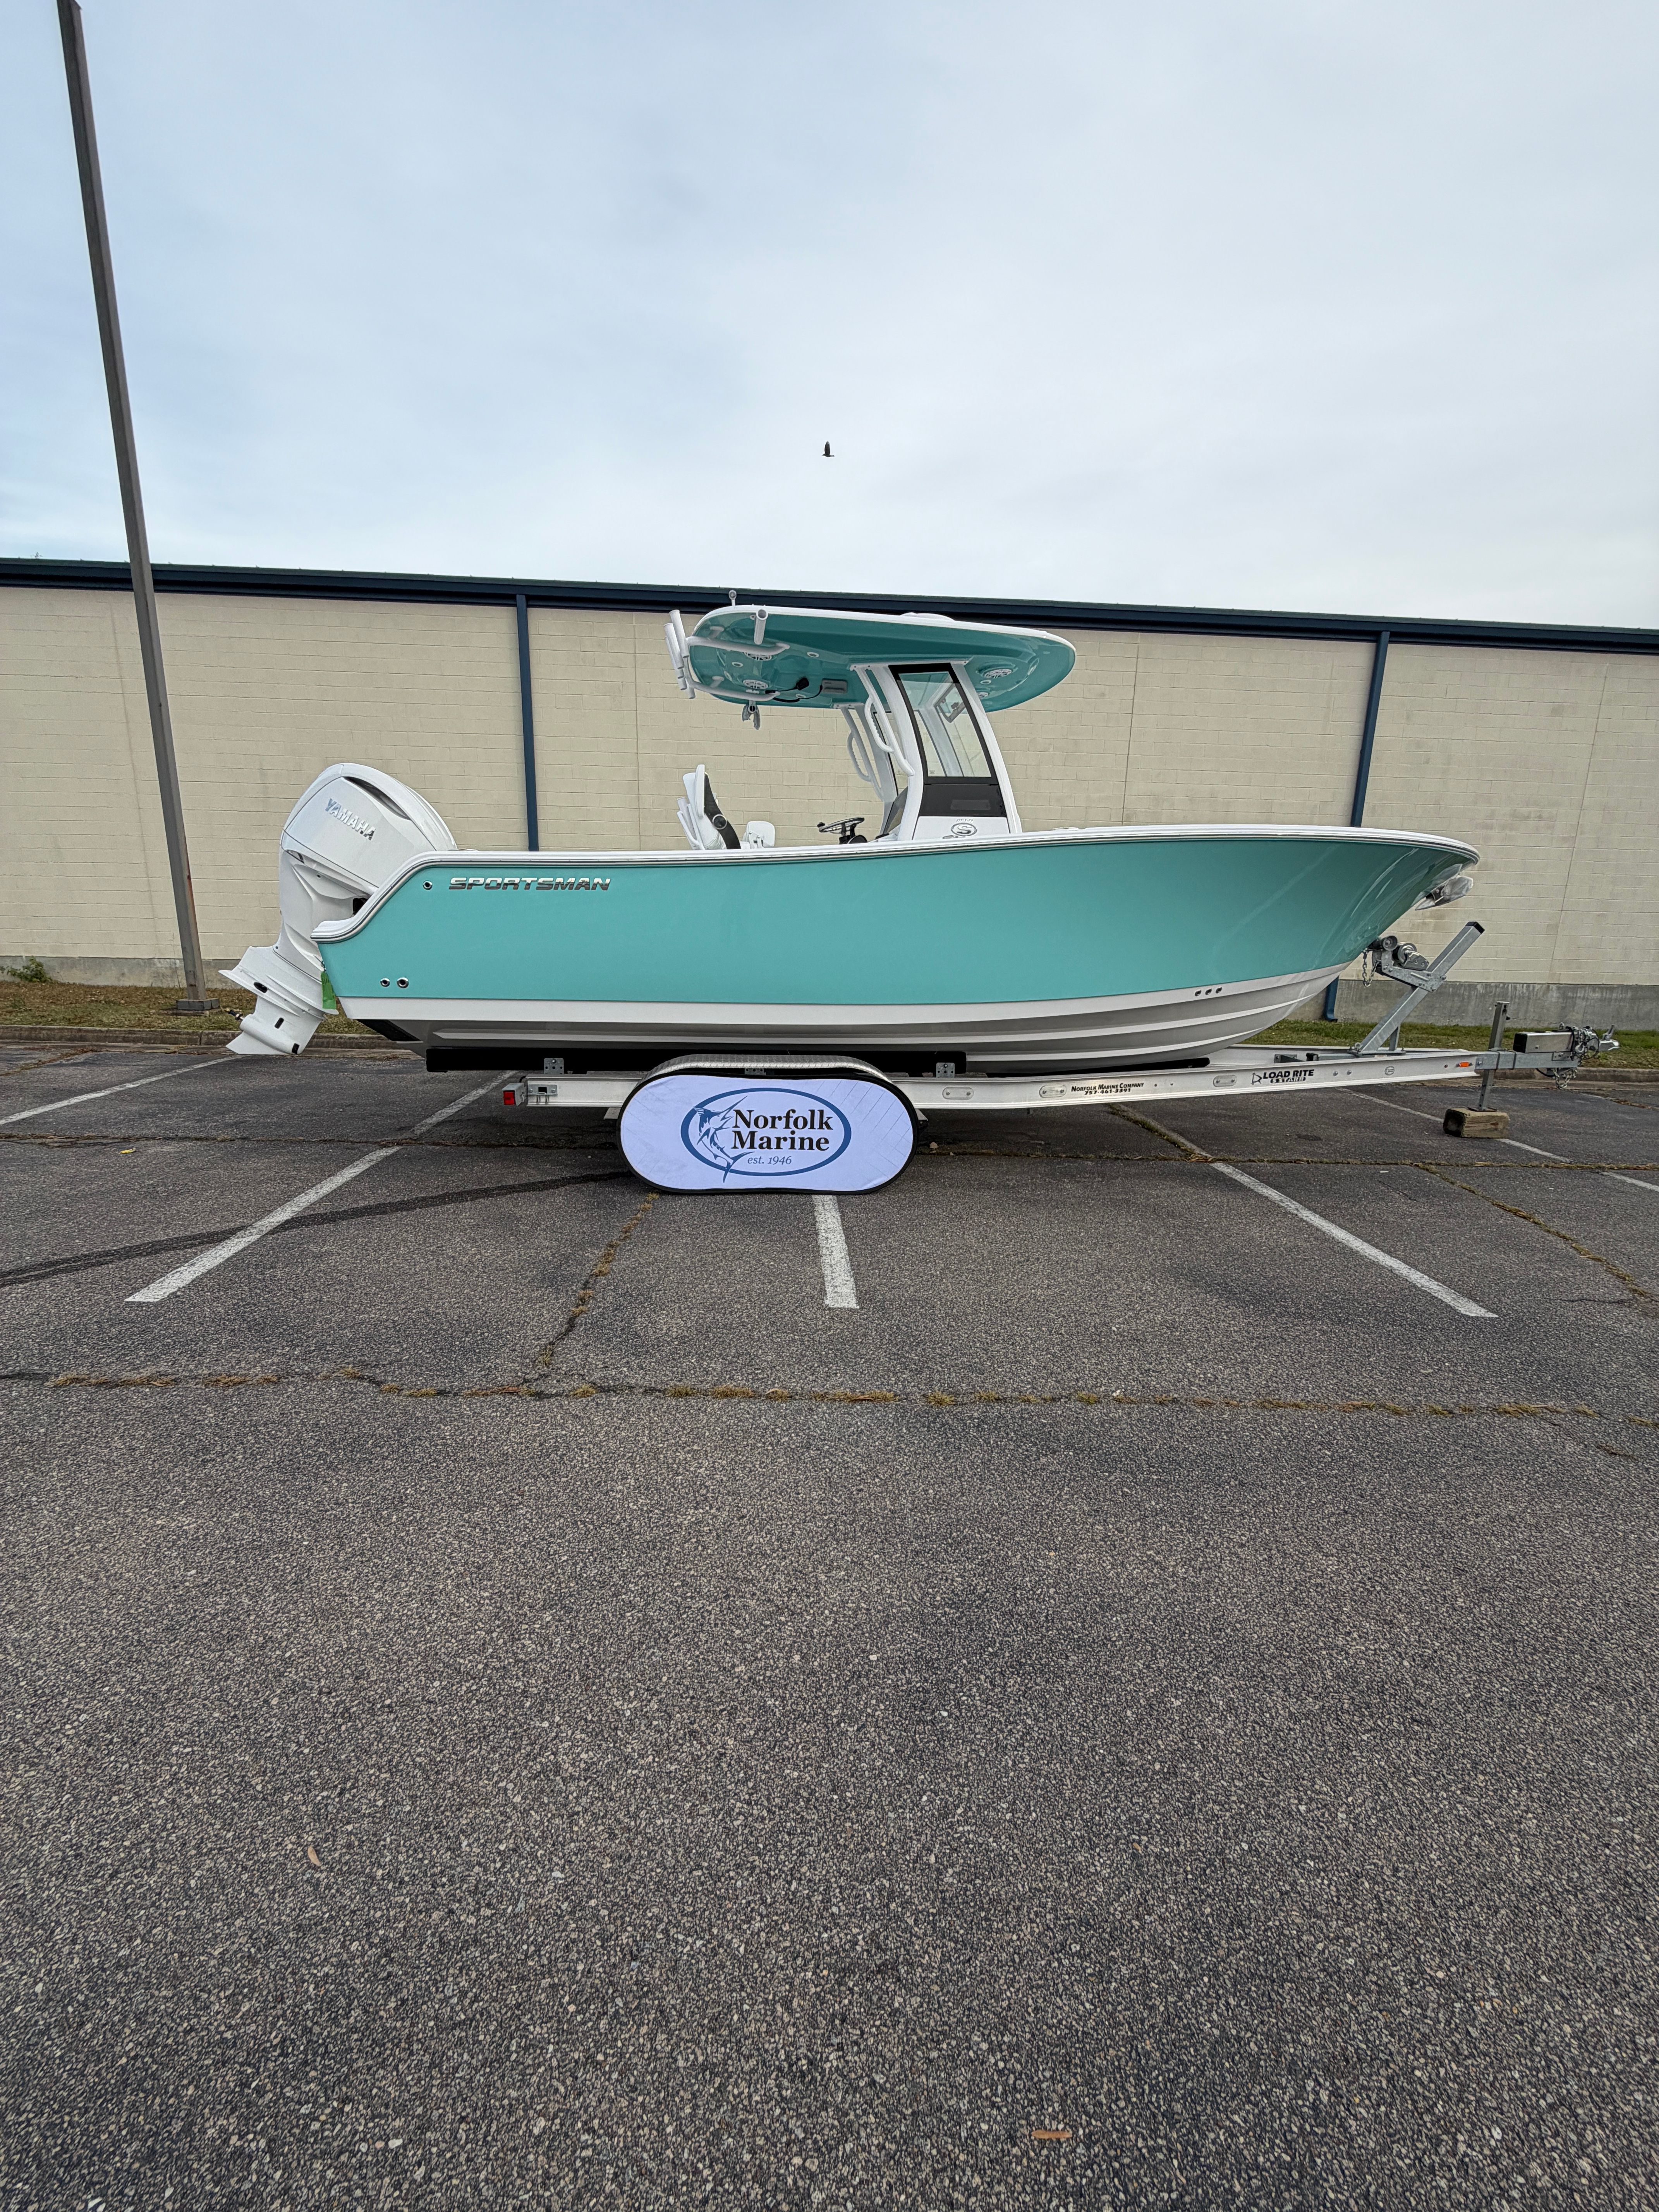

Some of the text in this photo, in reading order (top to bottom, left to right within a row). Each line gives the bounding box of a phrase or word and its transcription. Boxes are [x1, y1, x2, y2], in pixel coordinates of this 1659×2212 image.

[325, 798, 376, 841] YAMAHA
[448, 877, 611, 891] SPORTSMAN
[1263, 1069, 1314, 1079] LOAD RITE
[732, 1109, 833, 1130] Norfolk
[731, 1130, 829, 1151] Marine
[747, 1156, 792, 1165] est. 1946
